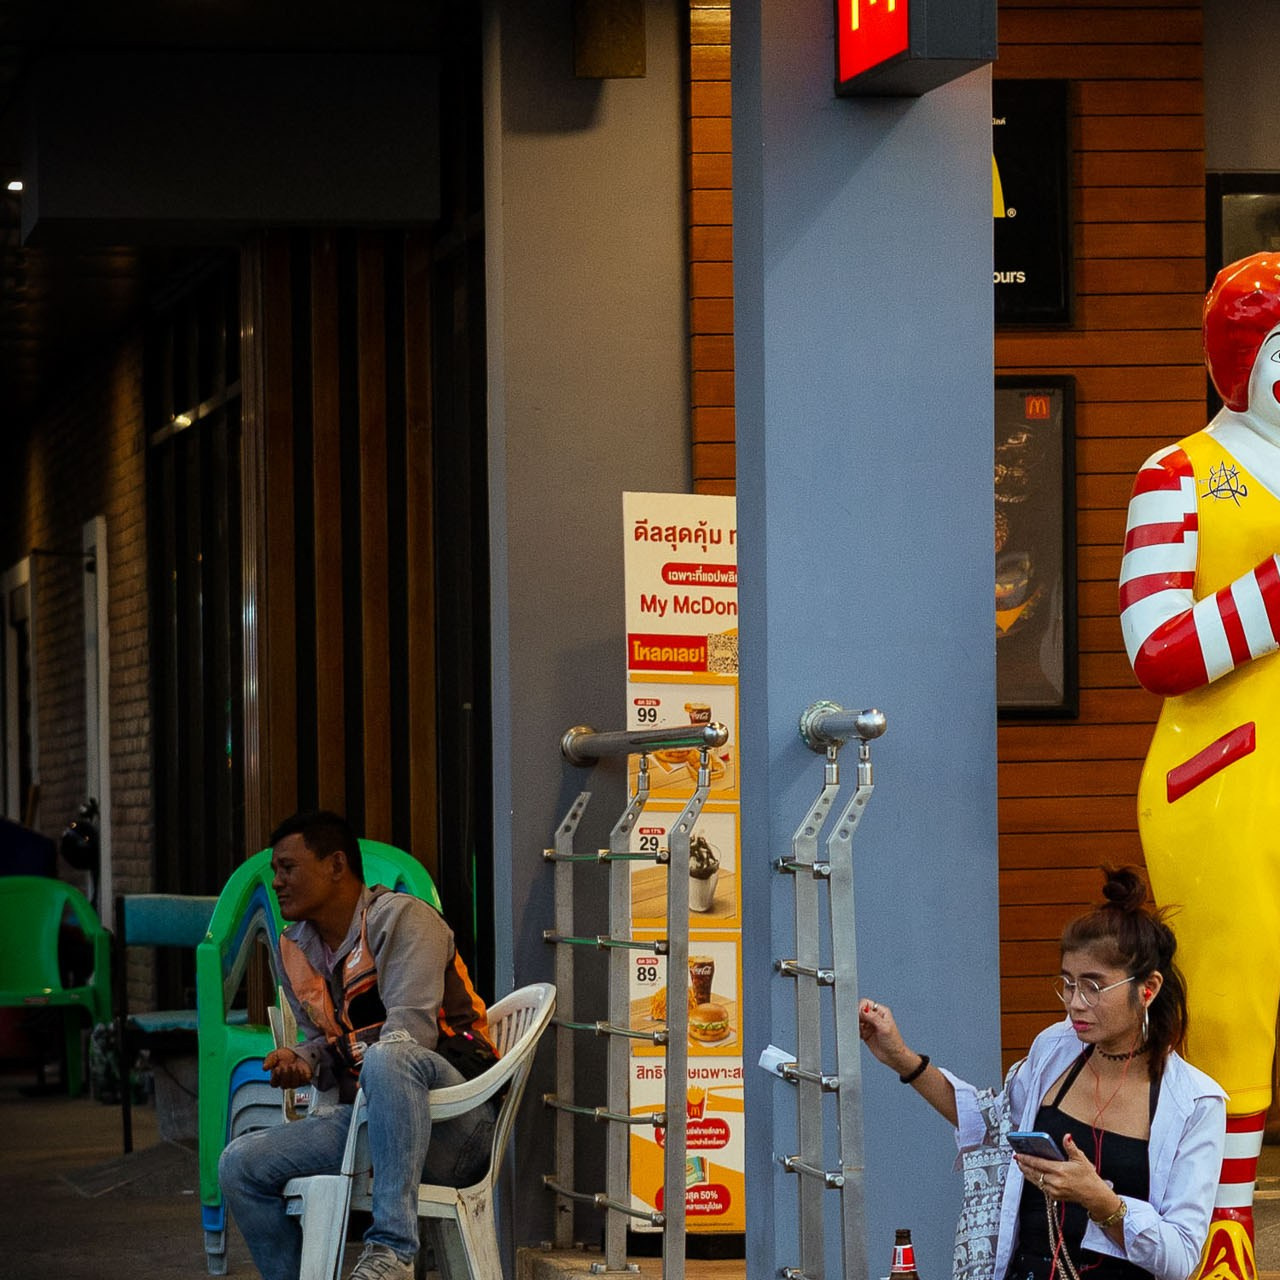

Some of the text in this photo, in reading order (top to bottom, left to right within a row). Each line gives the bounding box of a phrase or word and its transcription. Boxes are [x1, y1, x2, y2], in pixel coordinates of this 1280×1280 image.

[634, 518, 722, 553] ดีลสุดคุ้ม
[640, 594, 738, 618] My McDon
[632, 640, 705, 663] โหลดเลย!
[640, 836, 659, 851] 29
[700, 1190, 719, 1200] 50%
